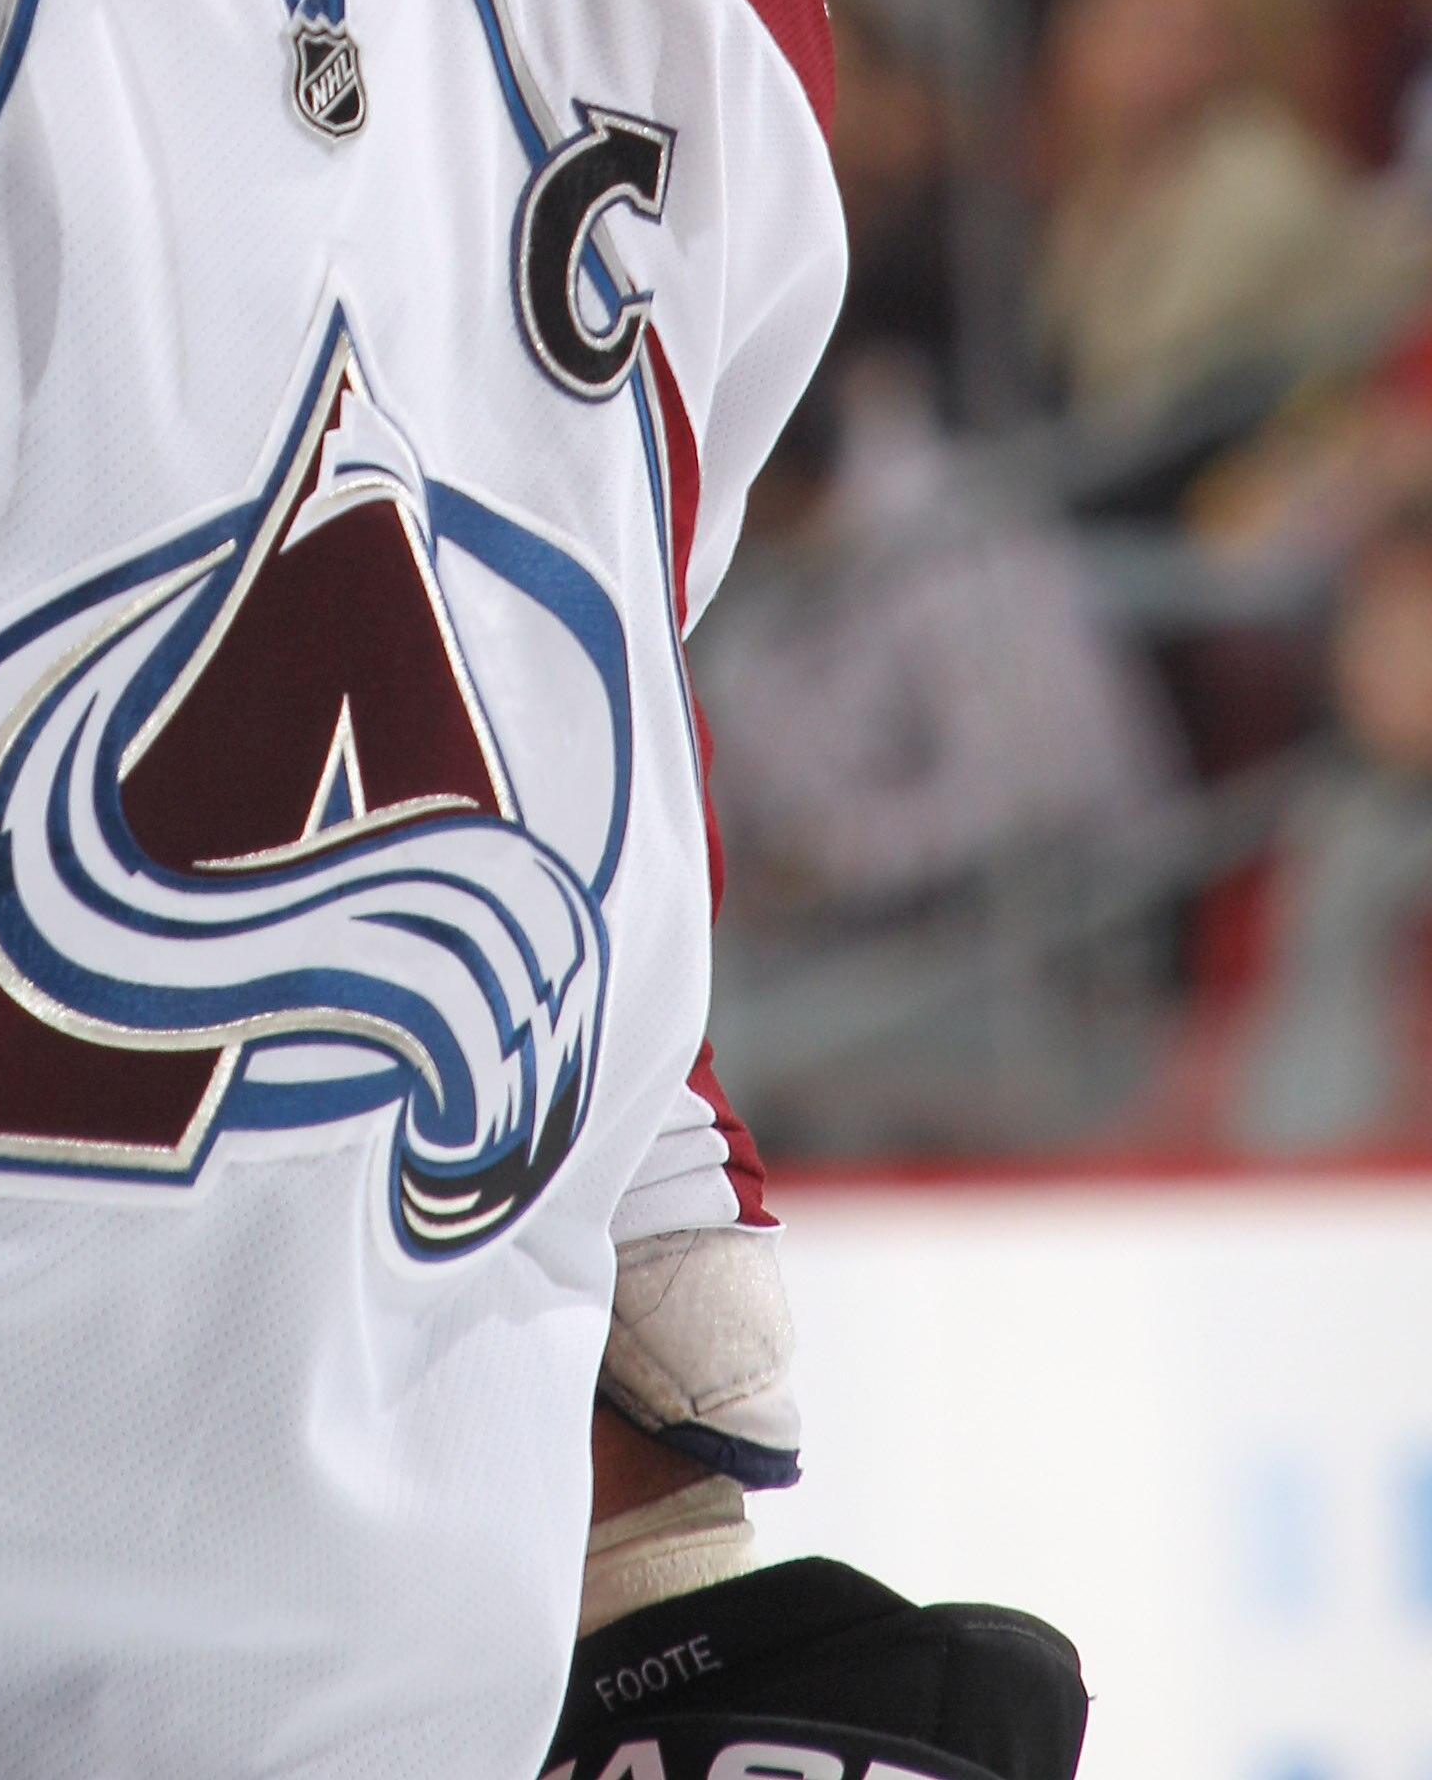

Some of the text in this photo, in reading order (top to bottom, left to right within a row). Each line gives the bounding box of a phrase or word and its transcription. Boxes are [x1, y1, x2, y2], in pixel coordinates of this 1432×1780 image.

[310, 52, 354, 115] NHL
[510, 97, 678, 404] C
[595, 1634, 722, 1712] FOOTE
